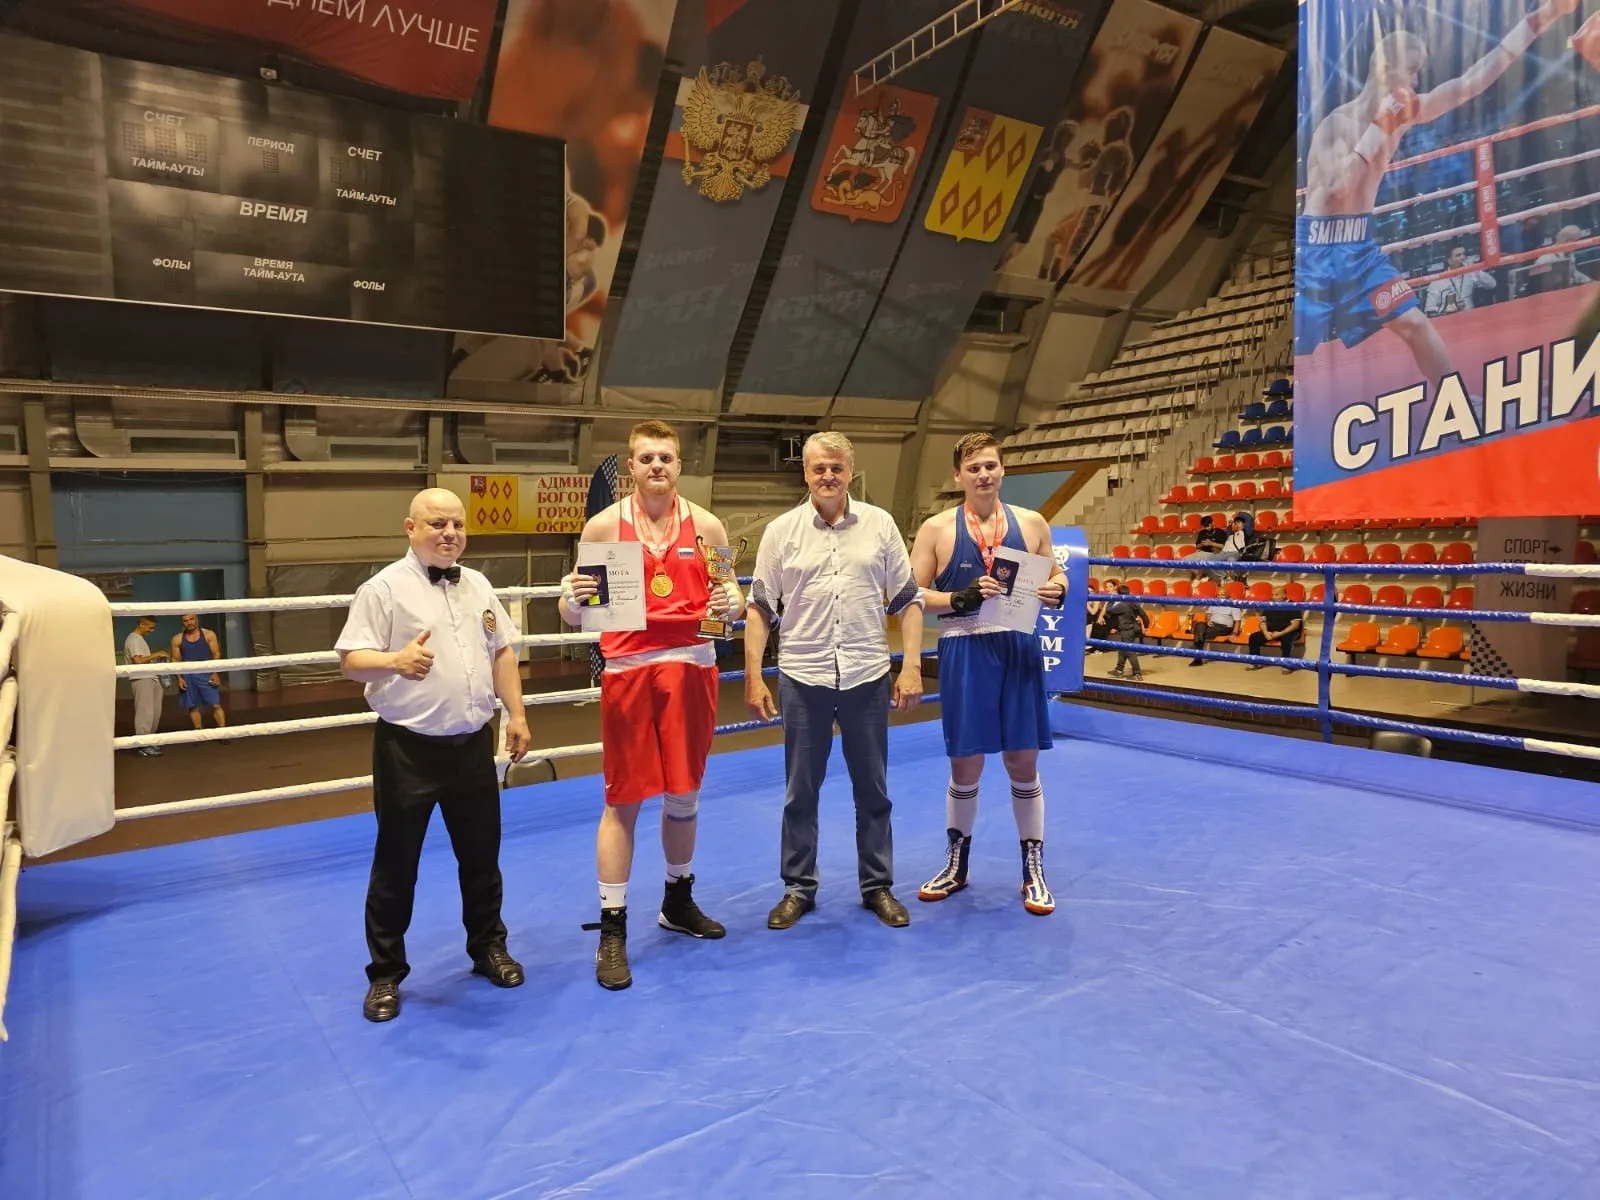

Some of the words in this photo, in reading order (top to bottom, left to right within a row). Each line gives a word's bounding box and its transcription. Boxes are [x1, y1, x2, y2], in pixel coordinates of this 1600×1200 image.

[371, 4, 480, 53] ЛУЧШЕ
[144, 110, 186, 127] СЧЕТ
[247, 136, 295, 154] ПЕРИОД
[347, 146, 382, 161] СЧЕТ
[131, 156, 205, 176] ТАЙМ-АУТЫ
[335, 188, 397, 206] ТАЙМ-АУТЫ
[239, 201, 308, 224] ВРЕМЯ
[1307, 217, 1369, 245] SMIRNOV
[152, 257, 191, 270] ФОЛЫ
[254, 257, 294, 270] ВРЕМЯ
[243, 268, 305, 283] ТАЙМ-АУТА
[353, 280, 385, 291] ФОЛЫ
[1504, 538, 1550, 554] СПОРТ
[1499, 580, 1556, 600] ЖИЗНИ
